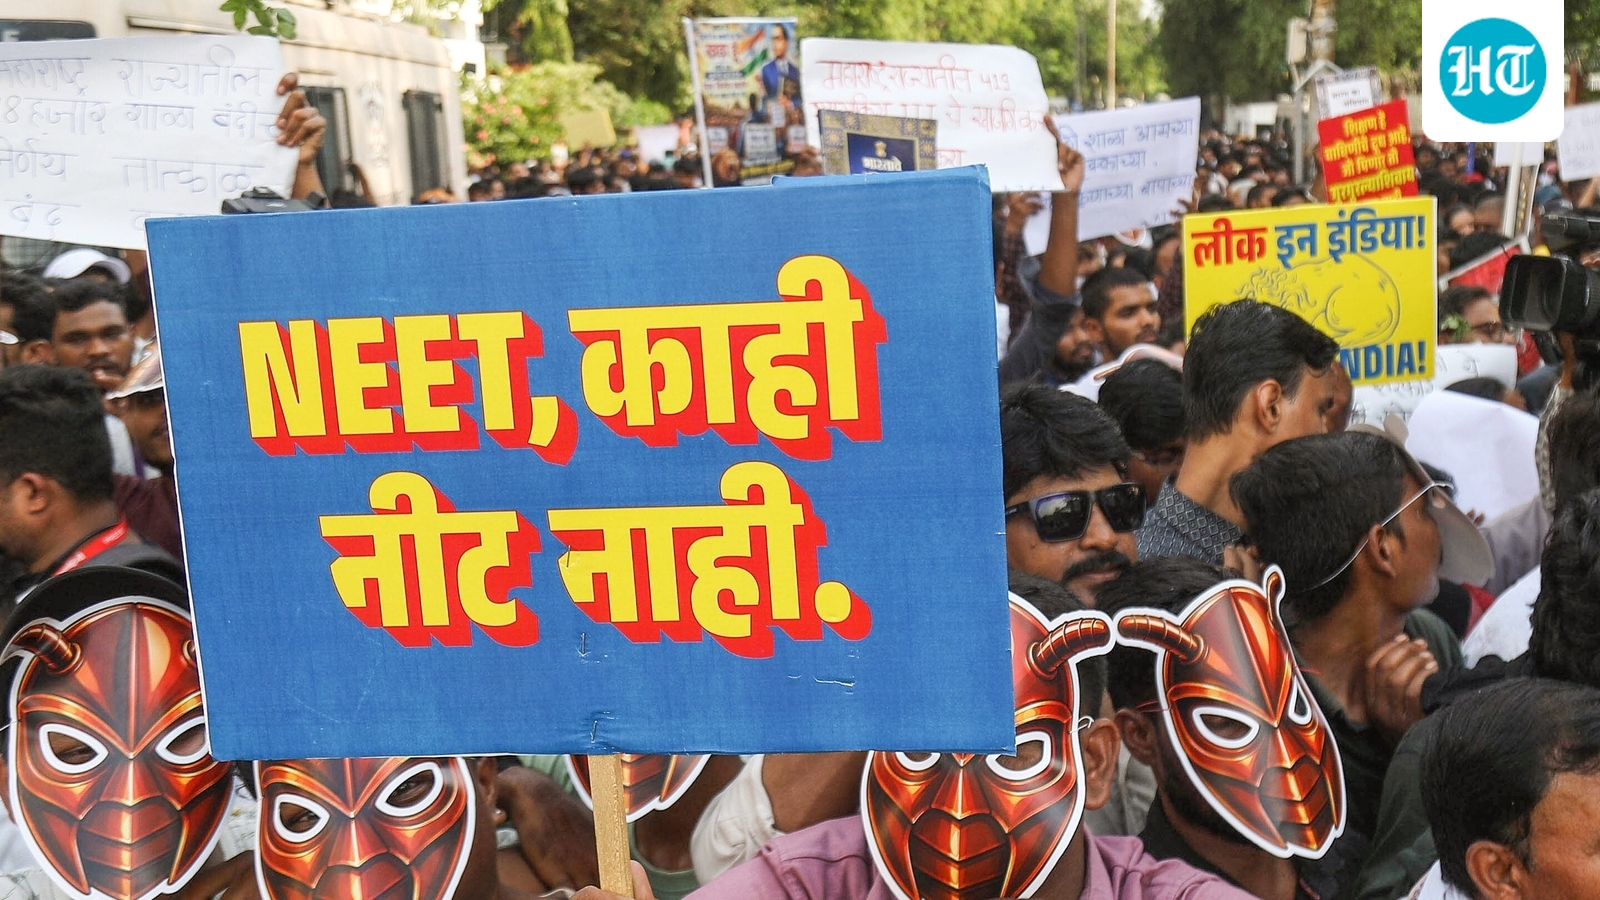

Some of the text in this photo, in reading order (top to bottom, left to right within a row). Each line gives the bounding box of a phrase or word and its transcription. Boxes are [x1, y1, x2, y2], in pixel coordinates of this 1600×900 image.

[0, 95, 22, 124] 8
[1344, 109, 1387, 138] शिक्षण हे
[1387, 146, 1399, 166] तो
[1191, 208, 1426, 269] लीक इन इंडिया!
[238, 255, 887, 465] NEET, काही
[1339, 341, 1426, 381] NDIA!
[319, 460, 872, 658] नीट नाही.
